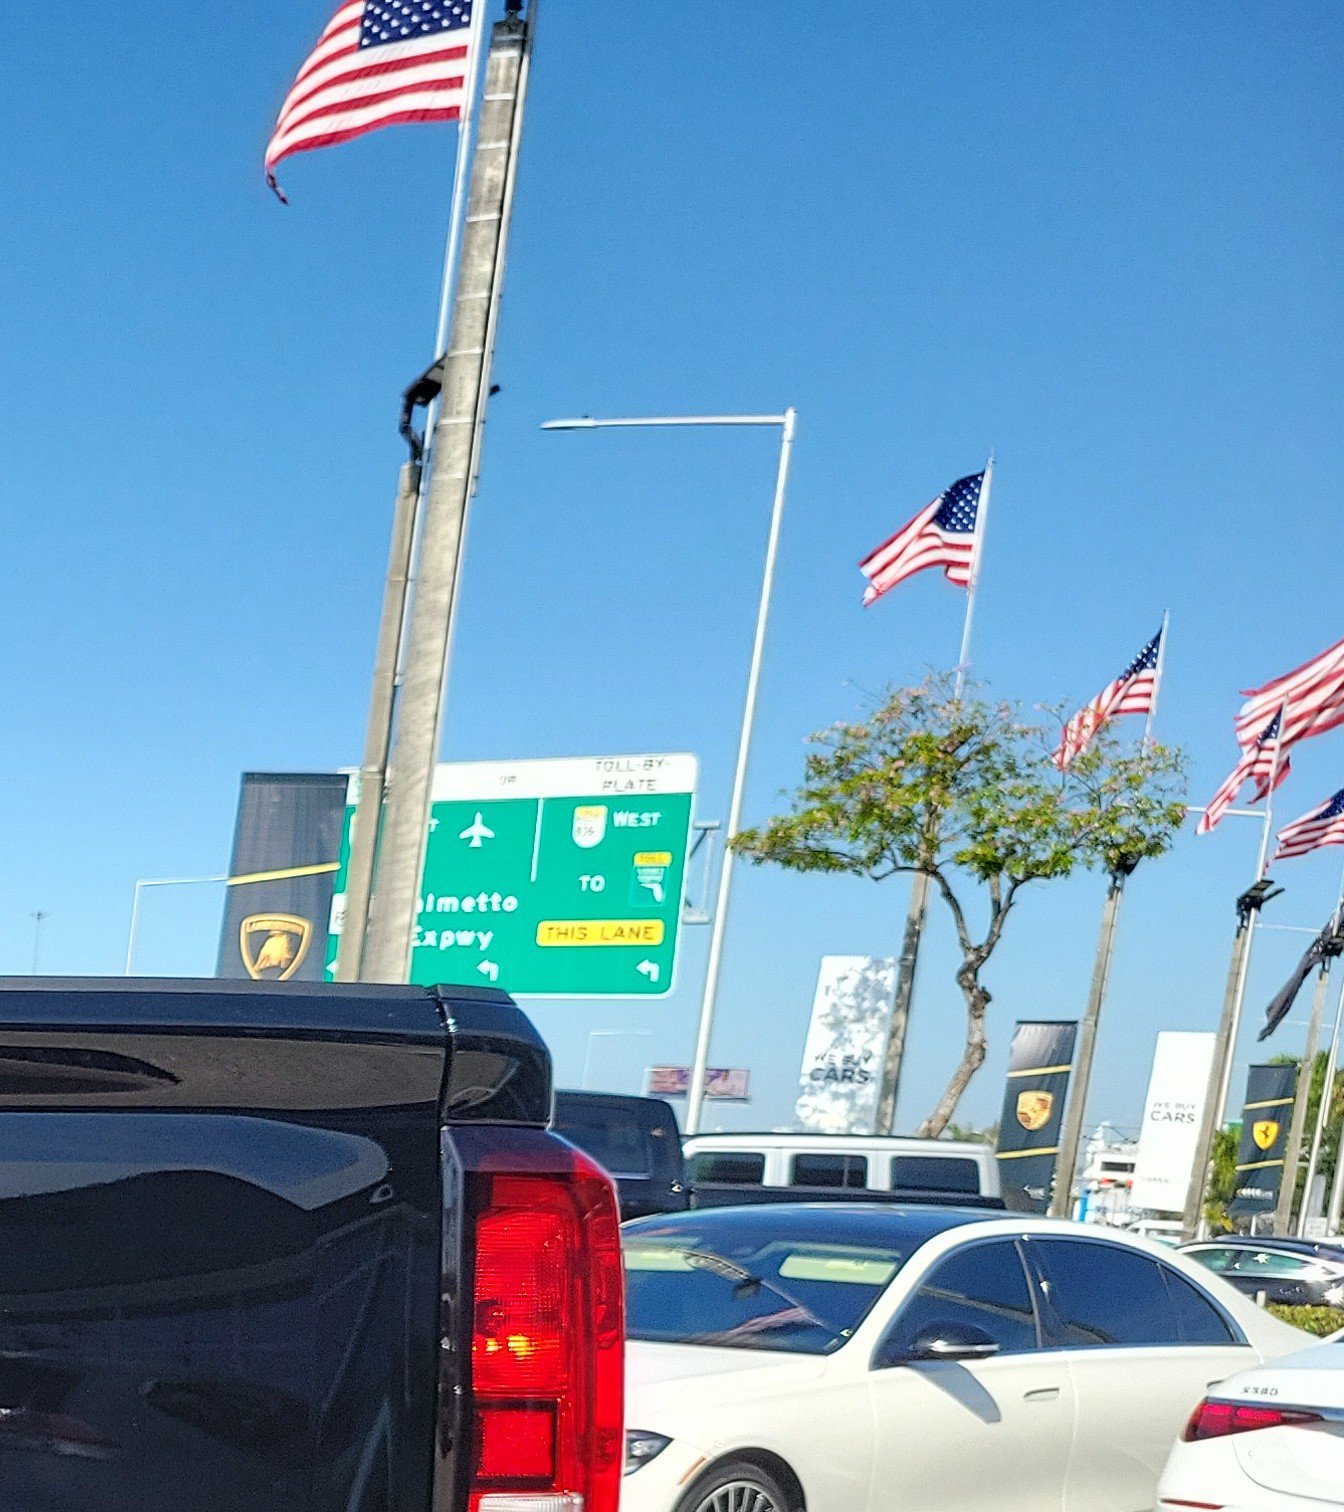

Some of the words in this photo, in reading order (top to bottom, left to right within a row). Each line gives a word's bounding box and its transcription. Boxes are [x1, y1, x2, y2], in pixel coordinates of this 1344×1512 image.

[602, 779, 657, 792] PLATE
[578, 874, 606, 892] TO
[547, 926, 588, 941] THIS
[600, 925, 656, 941] LANE
[809, 1067, 872, 1084] CARS
[1150, 1110, 1196, 1125] CARS
